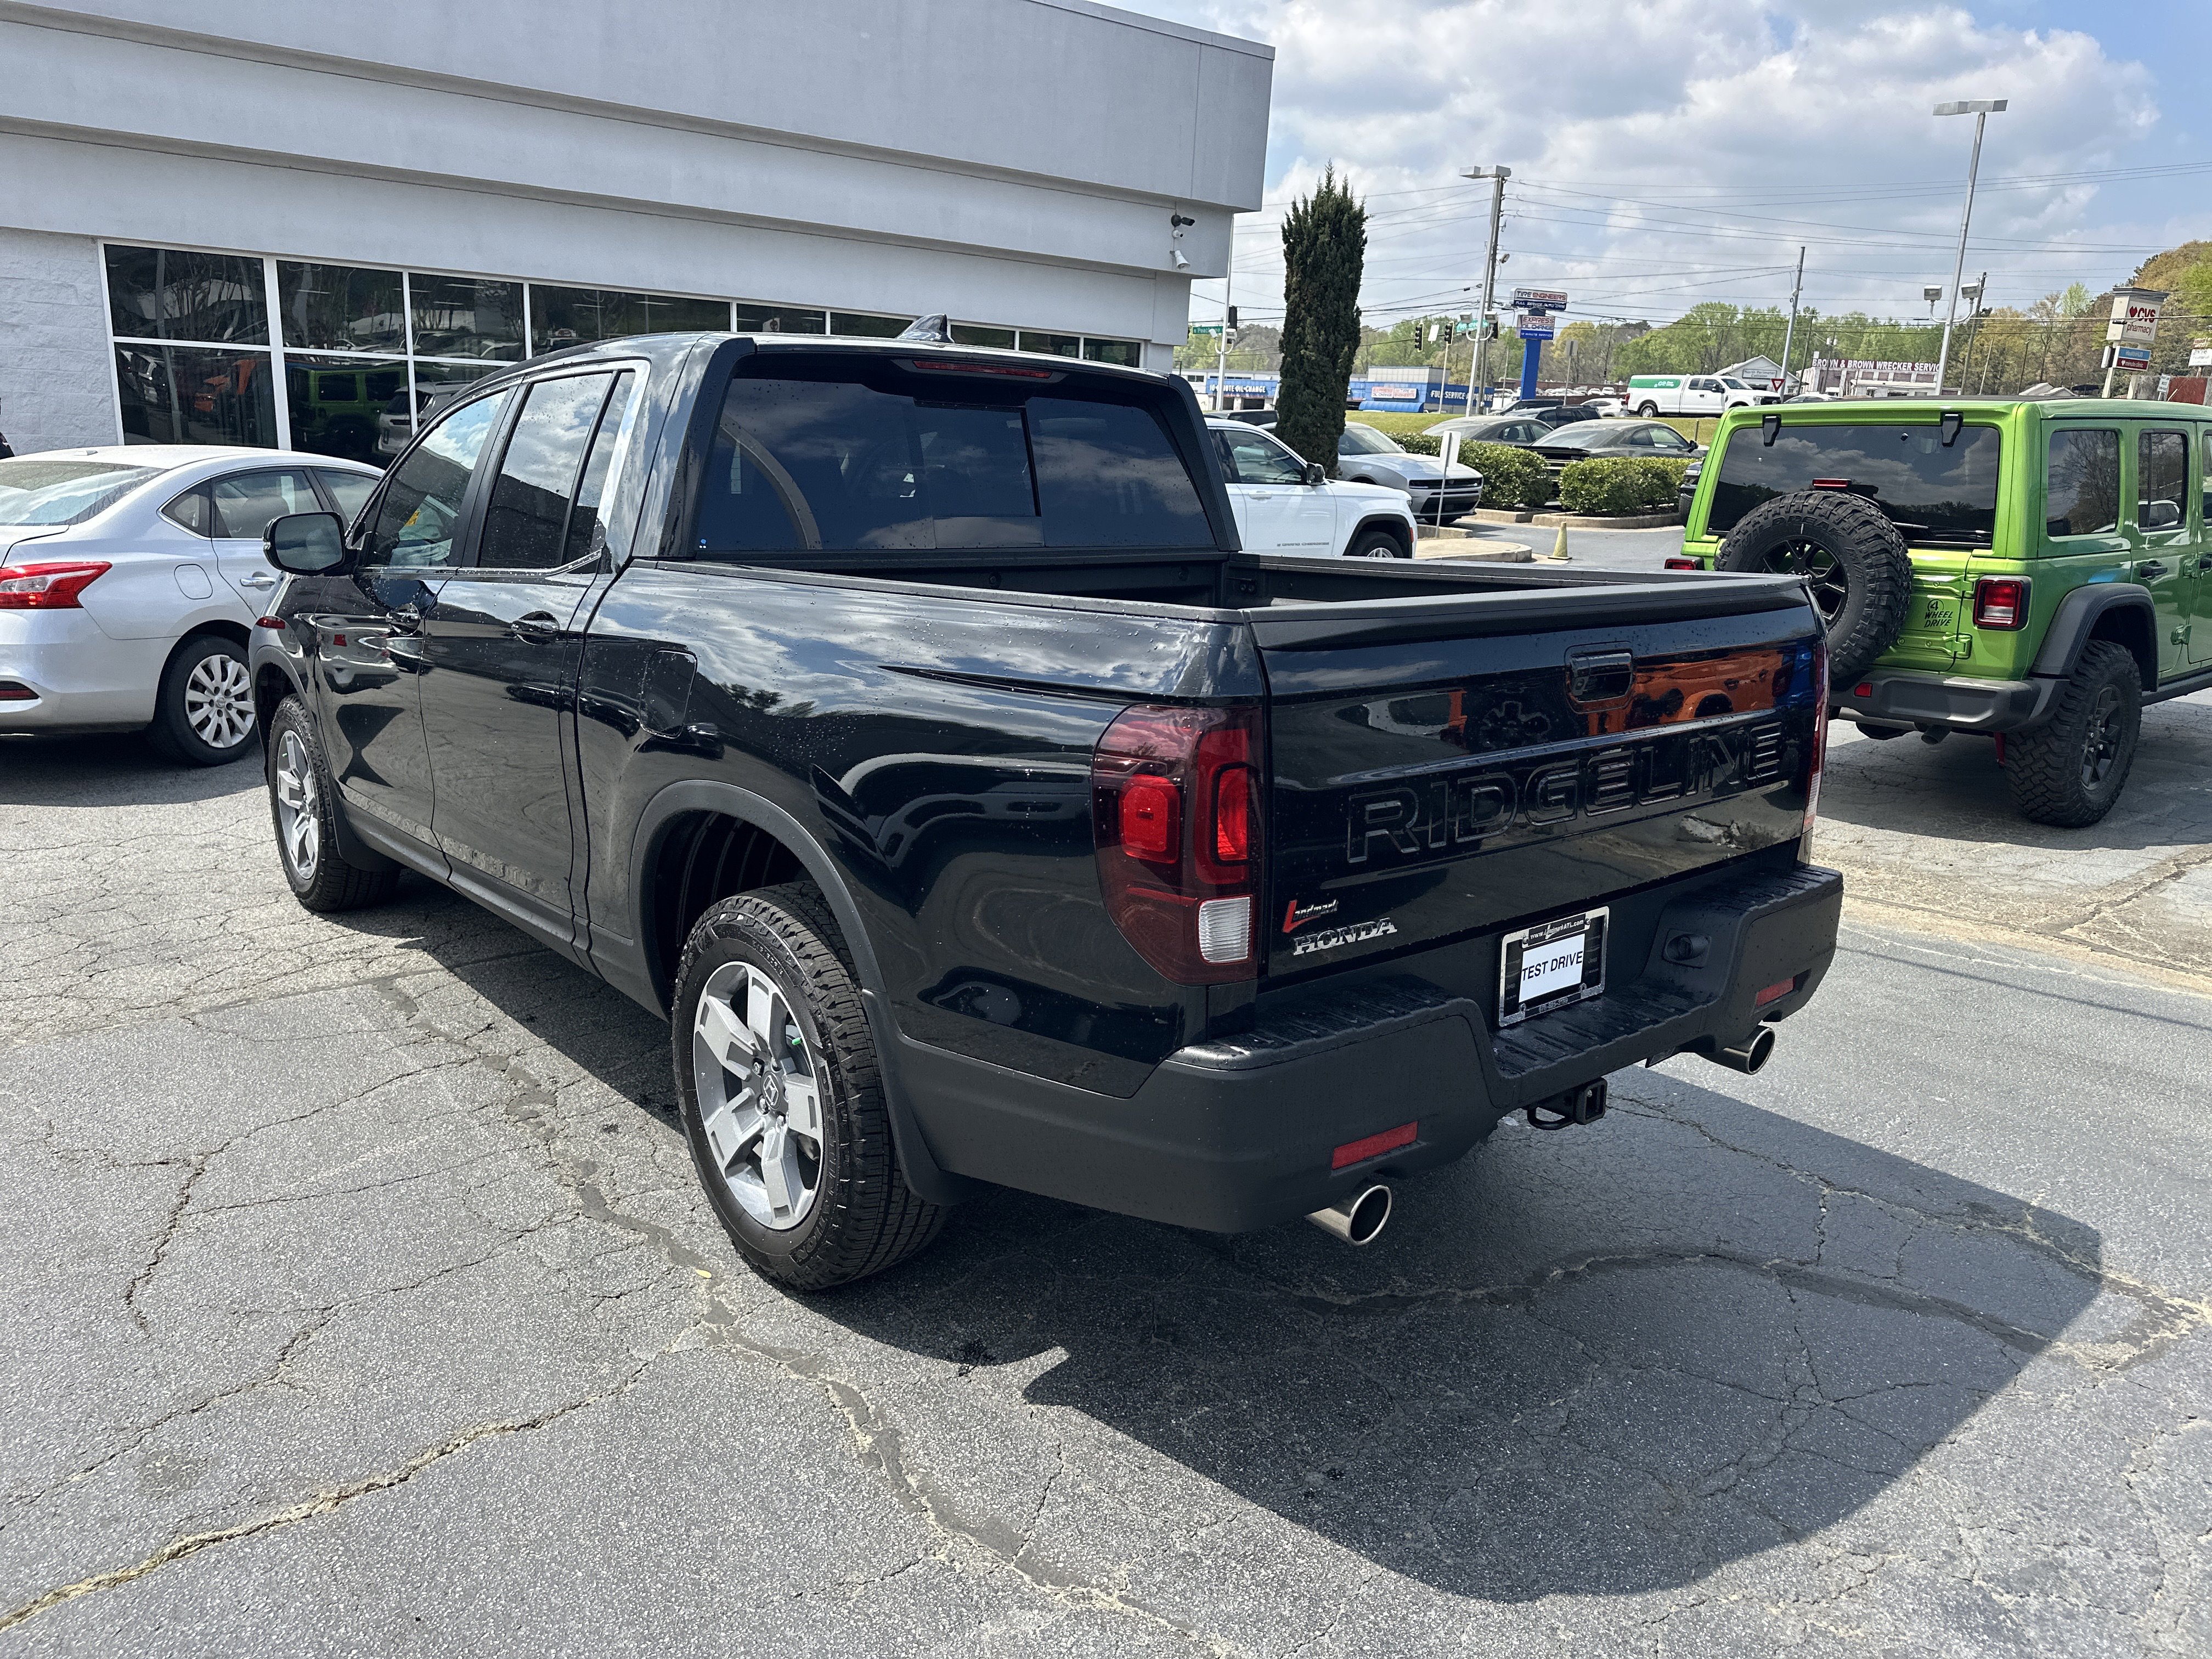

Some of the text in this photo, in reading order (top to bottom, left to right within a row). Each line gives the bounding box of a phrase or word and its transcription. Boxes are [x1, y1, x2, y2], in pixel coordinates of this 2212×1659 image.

[1533, 292, 1566, 301] ENGINEERS
[2137, 307, 2156, 323] CVS
[2126, 323, 2152, 335] pharmacy
[1839, 359, 1846, 368] &
[1847, 359, 1875, 370] BROWN
[1876, 360, 1912, 371] WRECKER
[1914, 363, 1941, 372] SERVIC
[1444, 391, 1465, 400] SERVICE
[1930, 601, 1939, 611] 4
[1925, 611, 1953, 619] WHEEL
[1924, 619, 1952, 628] DRIVE
[1347, 721, 1781, 864] RIDGELINE
[1291, 917, 1398, 956] HONDA
[1522, 950, 1583, 981] TEST DRIVE
